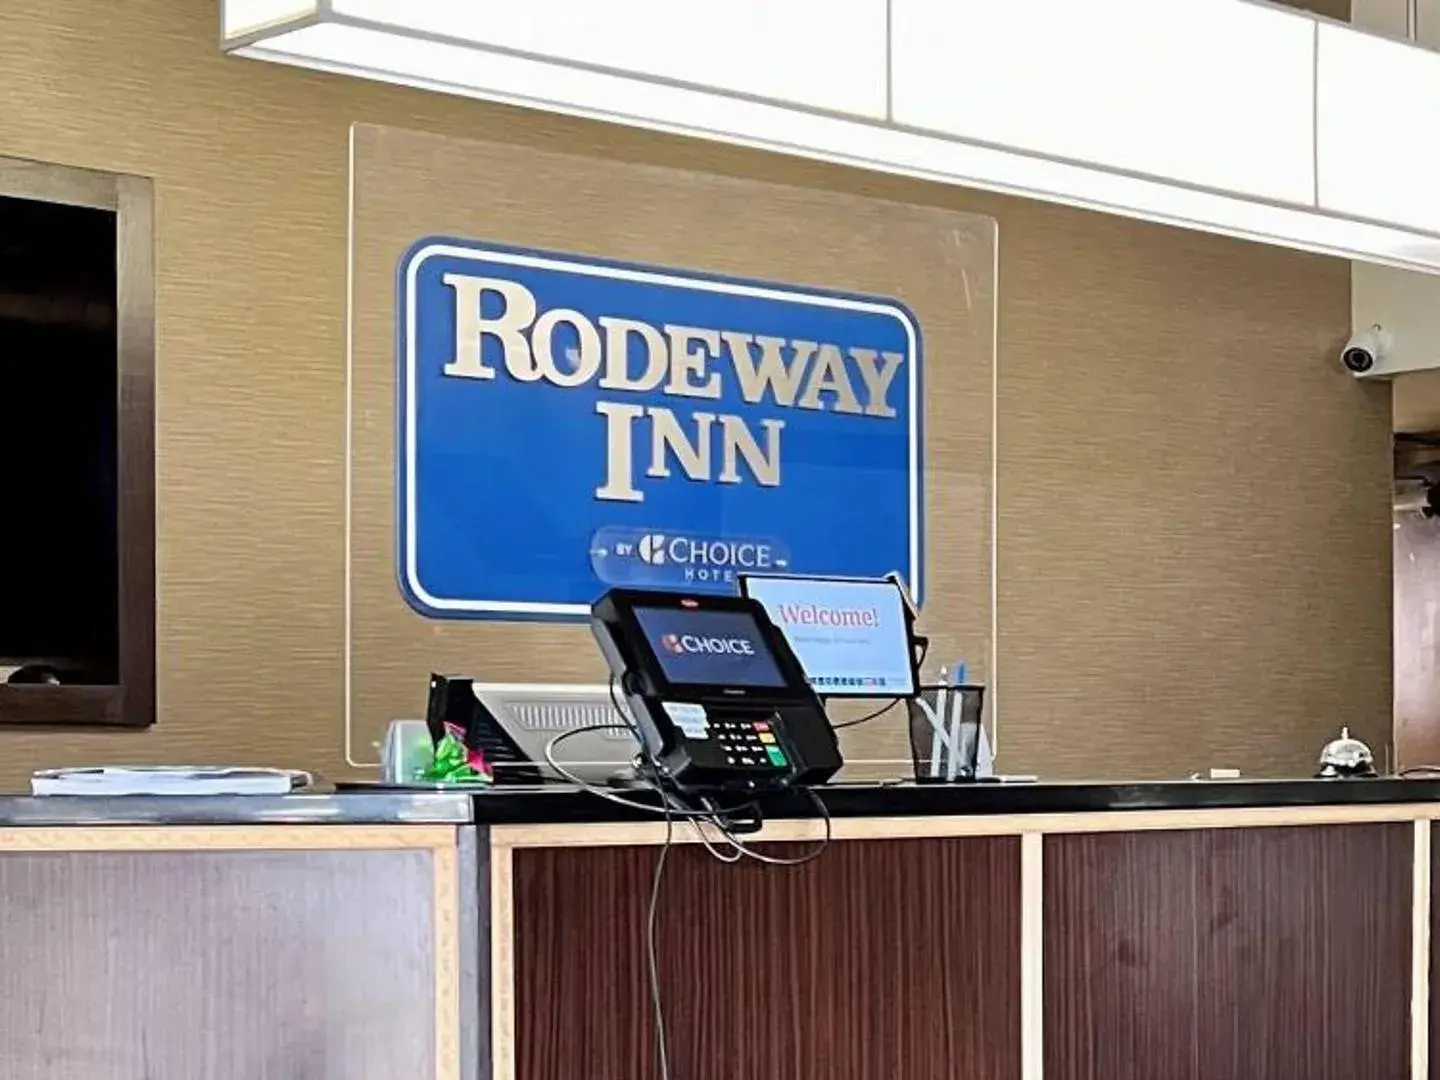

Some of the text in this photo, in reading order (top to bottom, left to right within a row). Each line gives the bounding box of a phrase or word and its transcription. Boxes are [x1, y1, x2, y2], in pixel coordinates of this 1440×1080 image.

[442, 272, 904, 418] RODEWAY
[594, 400, 786, 501] INN
[615, 537, 771, 568] BY CHOICE
[685, 568, 733, 583] HOTE
[779, 604, 879, 628] Welcome!
[681, 635, 755, 655] CHOICE
